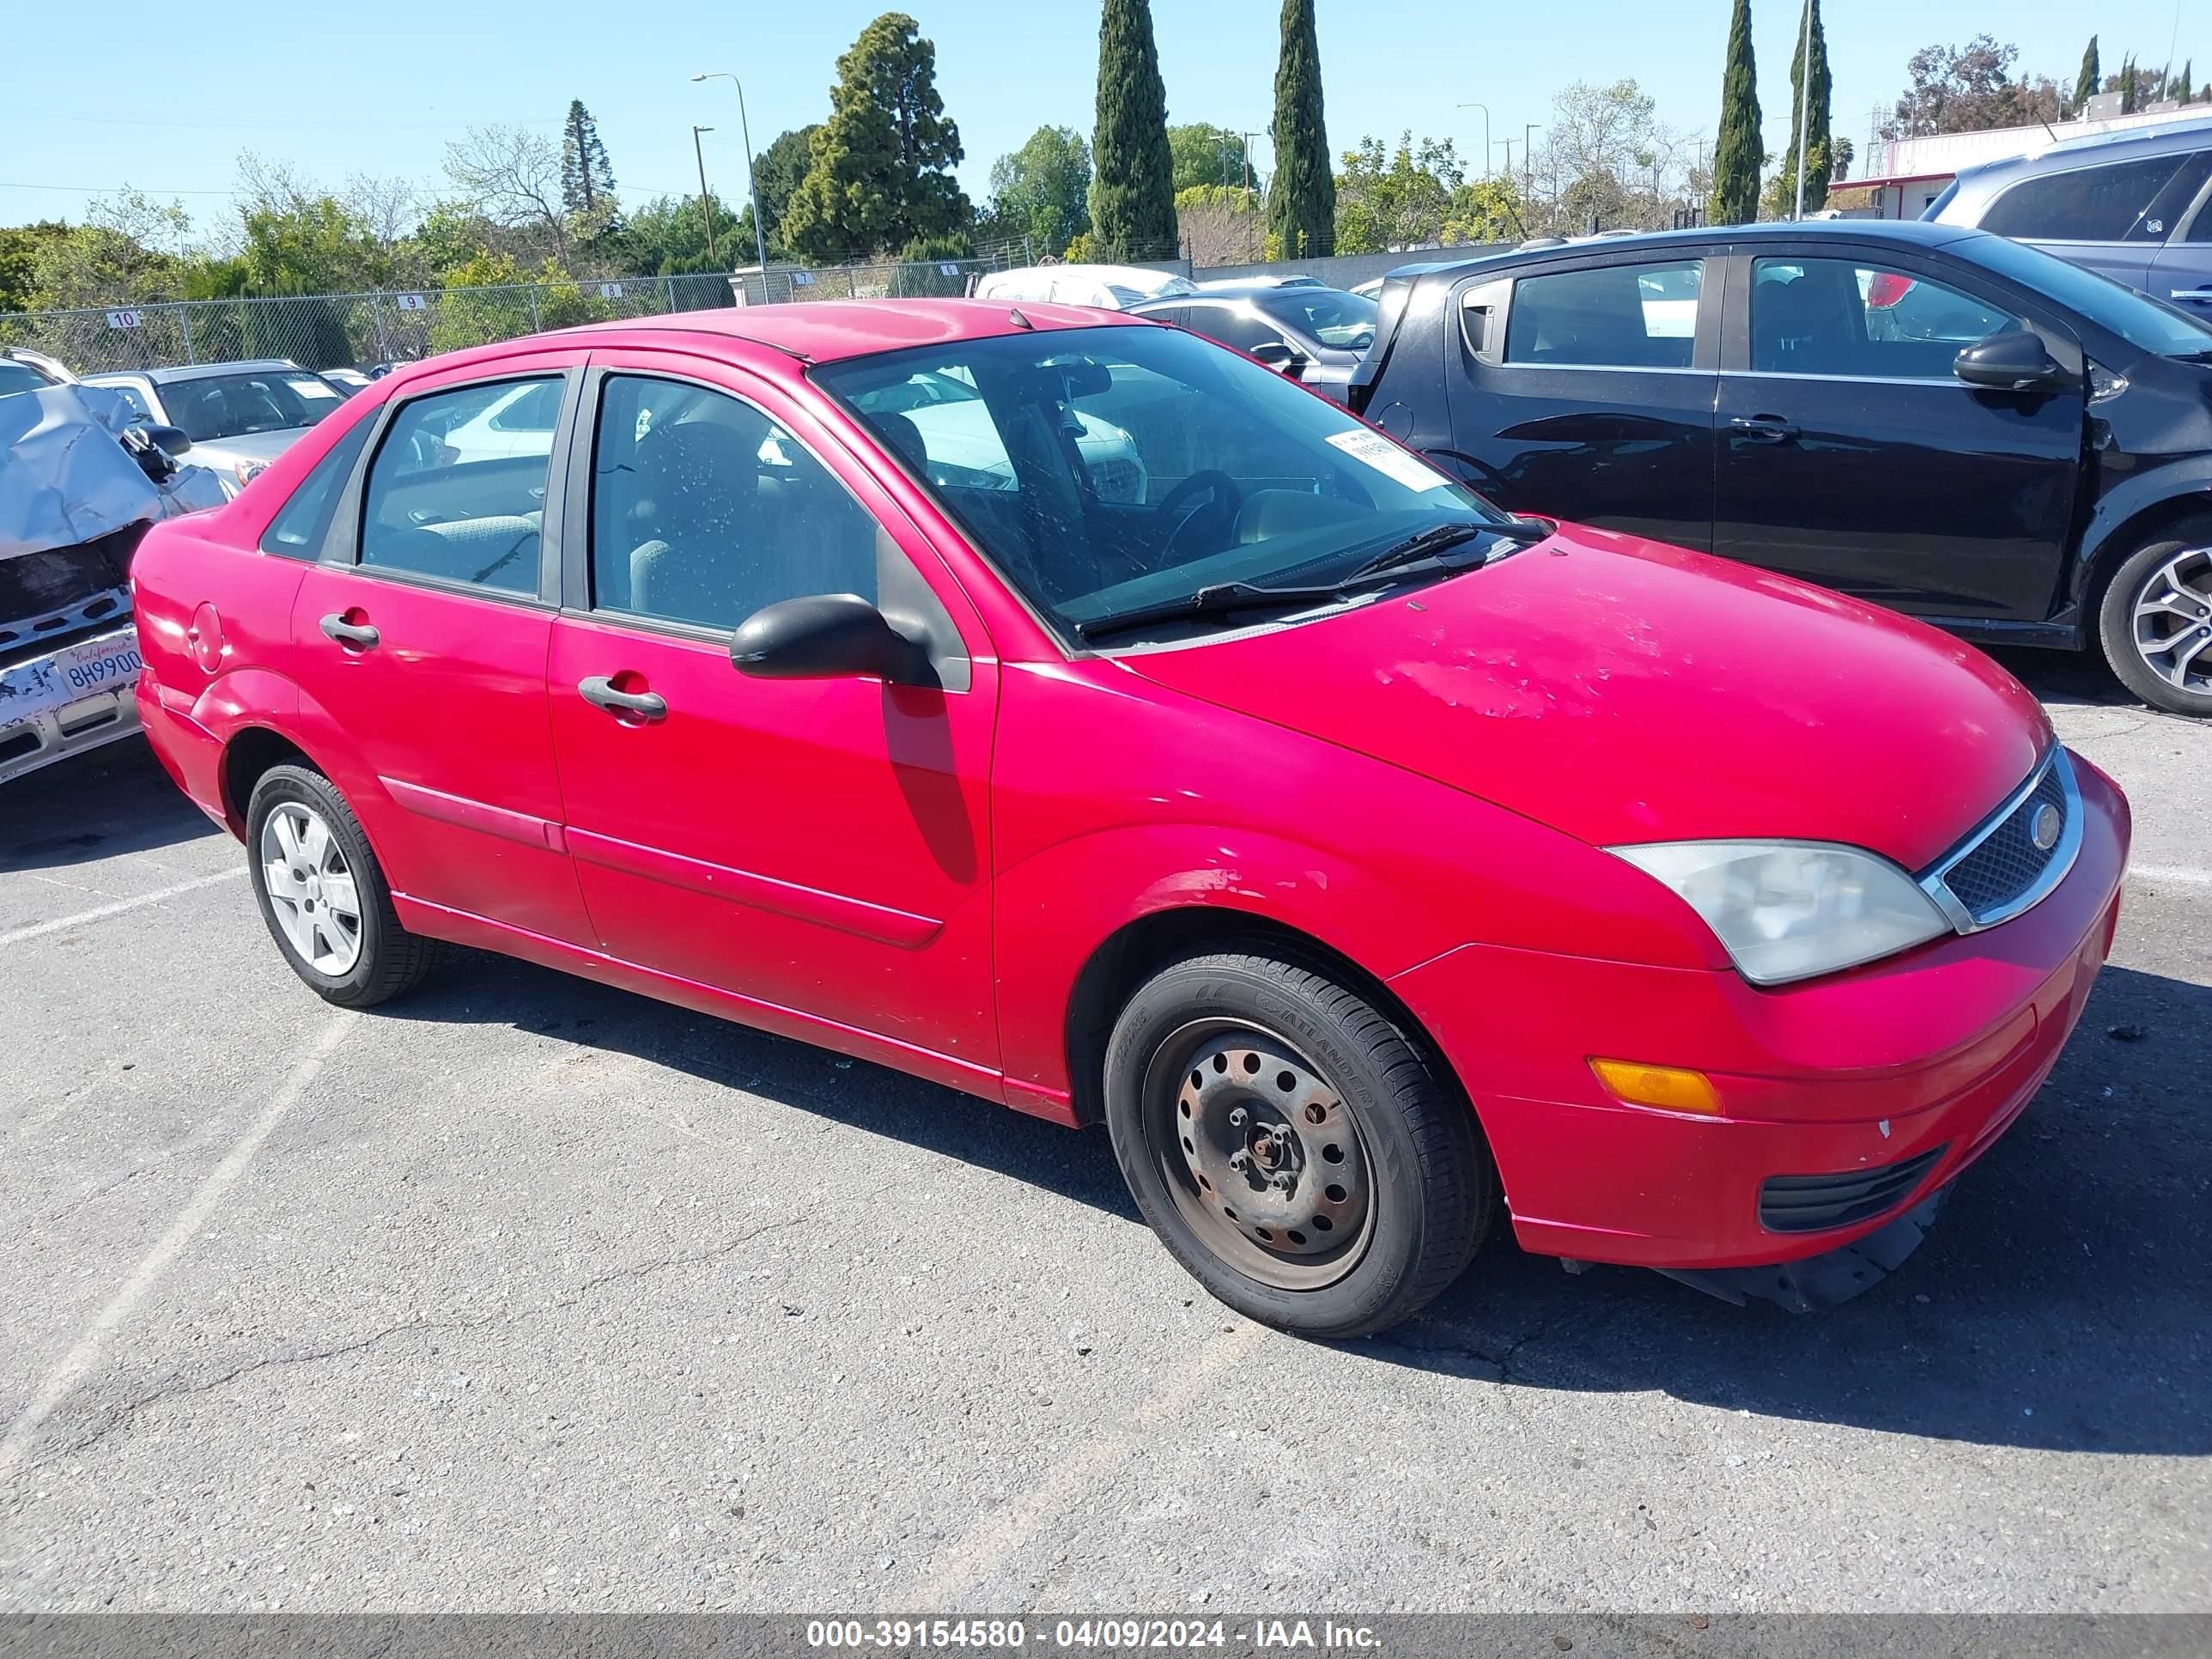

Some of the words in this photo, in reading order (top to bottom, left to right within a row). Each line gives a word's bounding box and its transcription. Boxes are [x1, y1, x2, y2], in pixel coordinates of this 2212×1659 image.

[608, 285, 616, 296] 8
[407, 296, 416, 308] 9
[114, 313, 135, 327] 10
[76, 641, 129, 663] California
[69, 650, 143, 688] 8H9900
